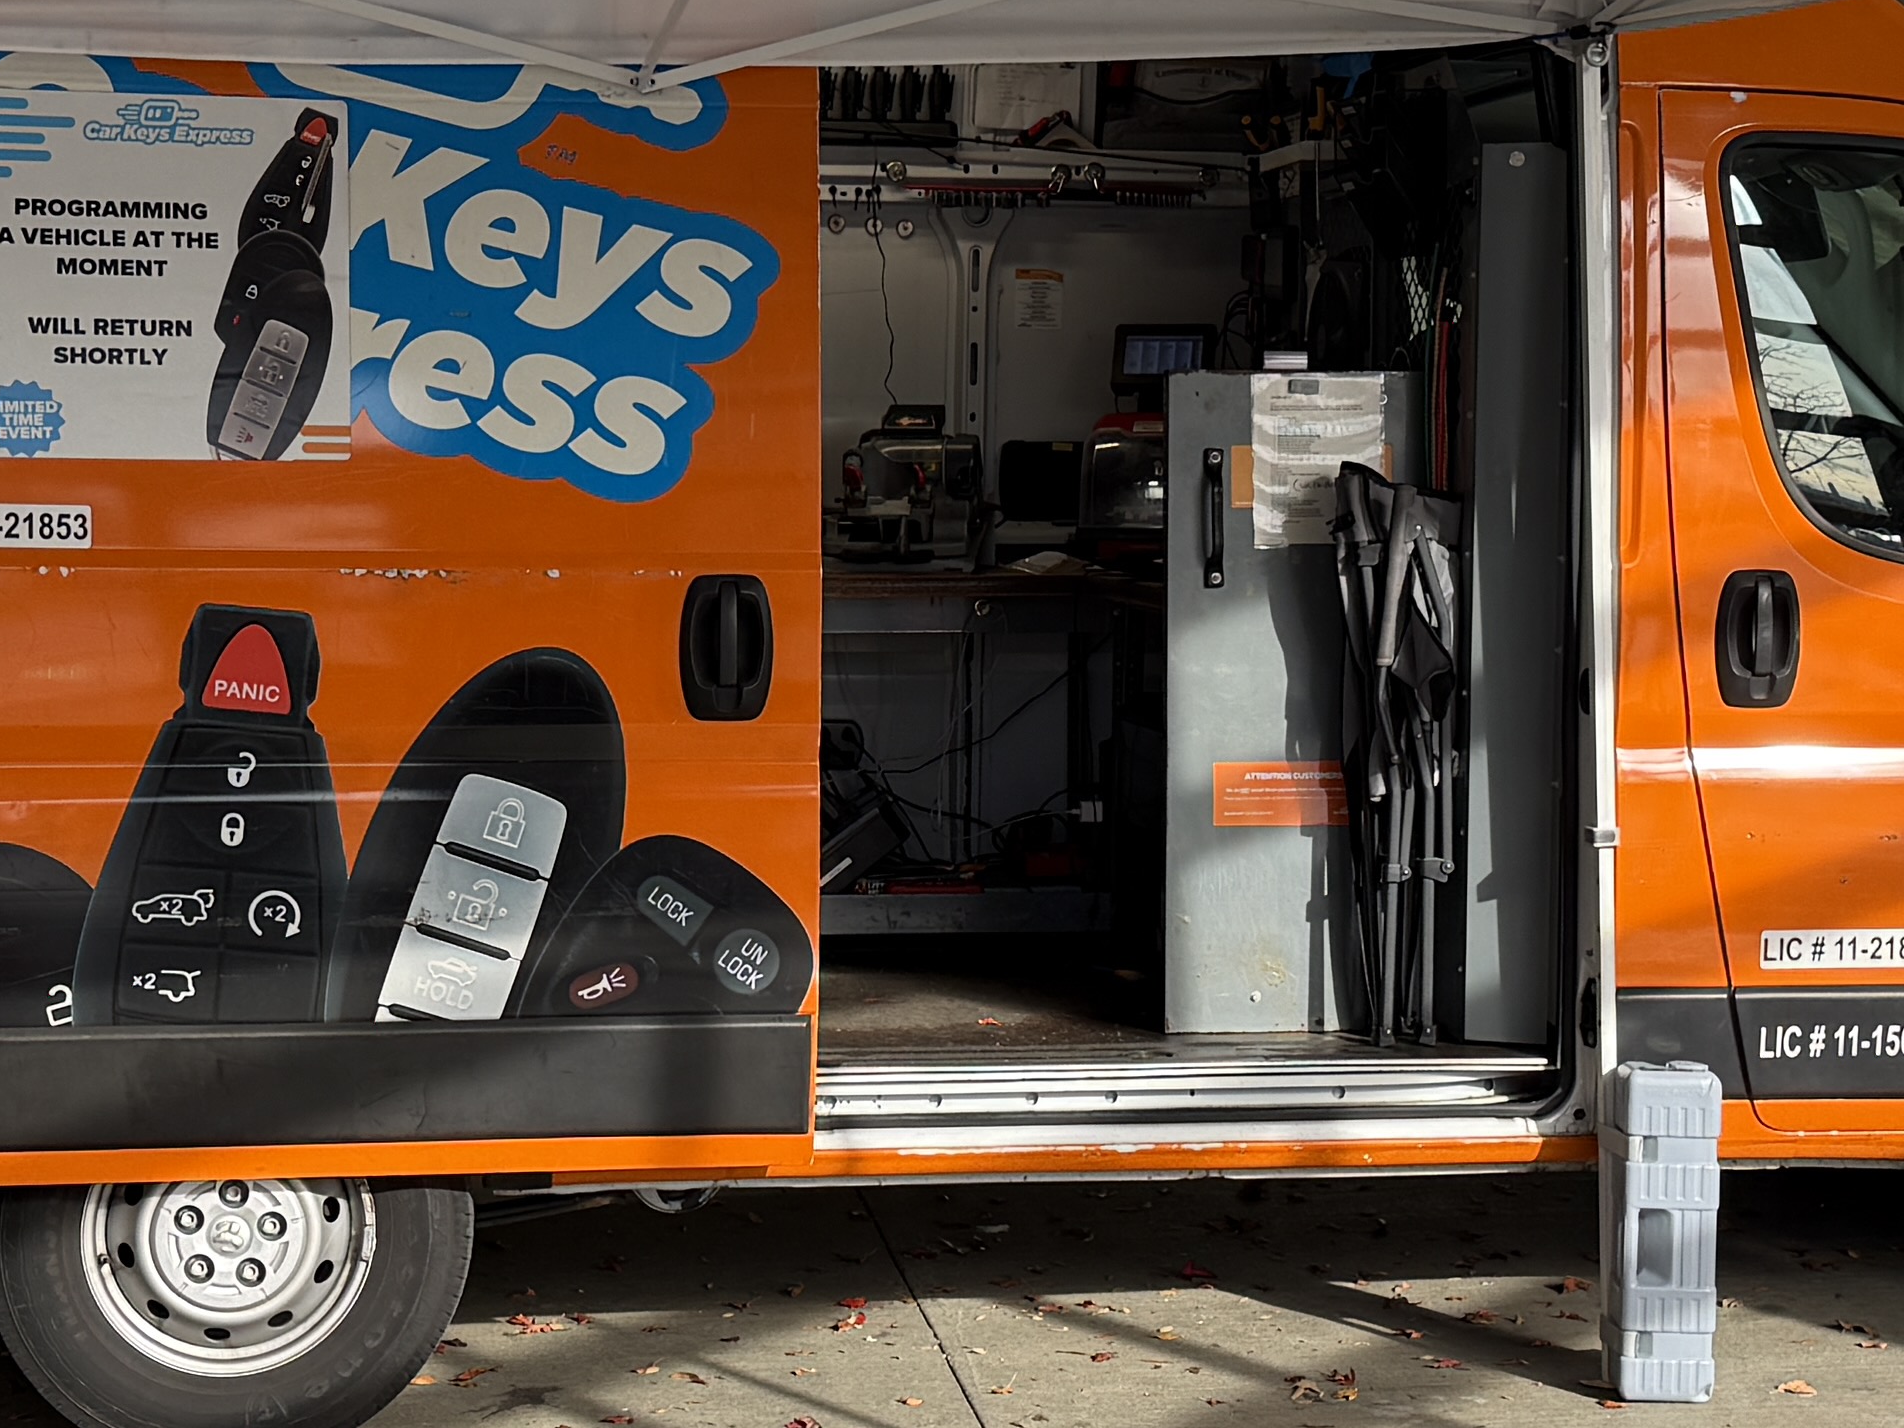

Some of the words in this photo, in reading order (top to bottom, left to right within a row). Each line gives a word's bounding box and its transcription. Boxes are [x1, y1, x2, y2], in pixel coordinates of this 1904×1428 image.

[84, 121, 121, 139] Car
[122, 123, 170, 144] Keys
[173, 126, 253, 145] Express
[14, 198, 208, 220] PROGRAMMING
[21, 228, 125, 246] VEHICLE
[132, 230, 165, 247] AT
[171, 232, 219, 249] THE
[350, 129, 753, 337] Keys
[56, 258, 167, 276] MOMENT
[28, 317, 85, 335] WILL
[94, 318, 192, 337] RETURN
[53, 347, 168, 366] SHORTLY
[2, 414, 44, 427] TIME
[214, 679, 280, 703] PANIC
[647, 886, 694, 926] LOCK
[741, 938, 768, 965] UN
[1763, 937, 1802, 961] LIC
[1811, 936, 1825, 961] #
[718, 949, 763, 990] LOCK
[414, 976, 473, 1010] HOLD
[1759, 1025, 1803, 1059] LIC
[1809, 1025, 1826, 1058] #
